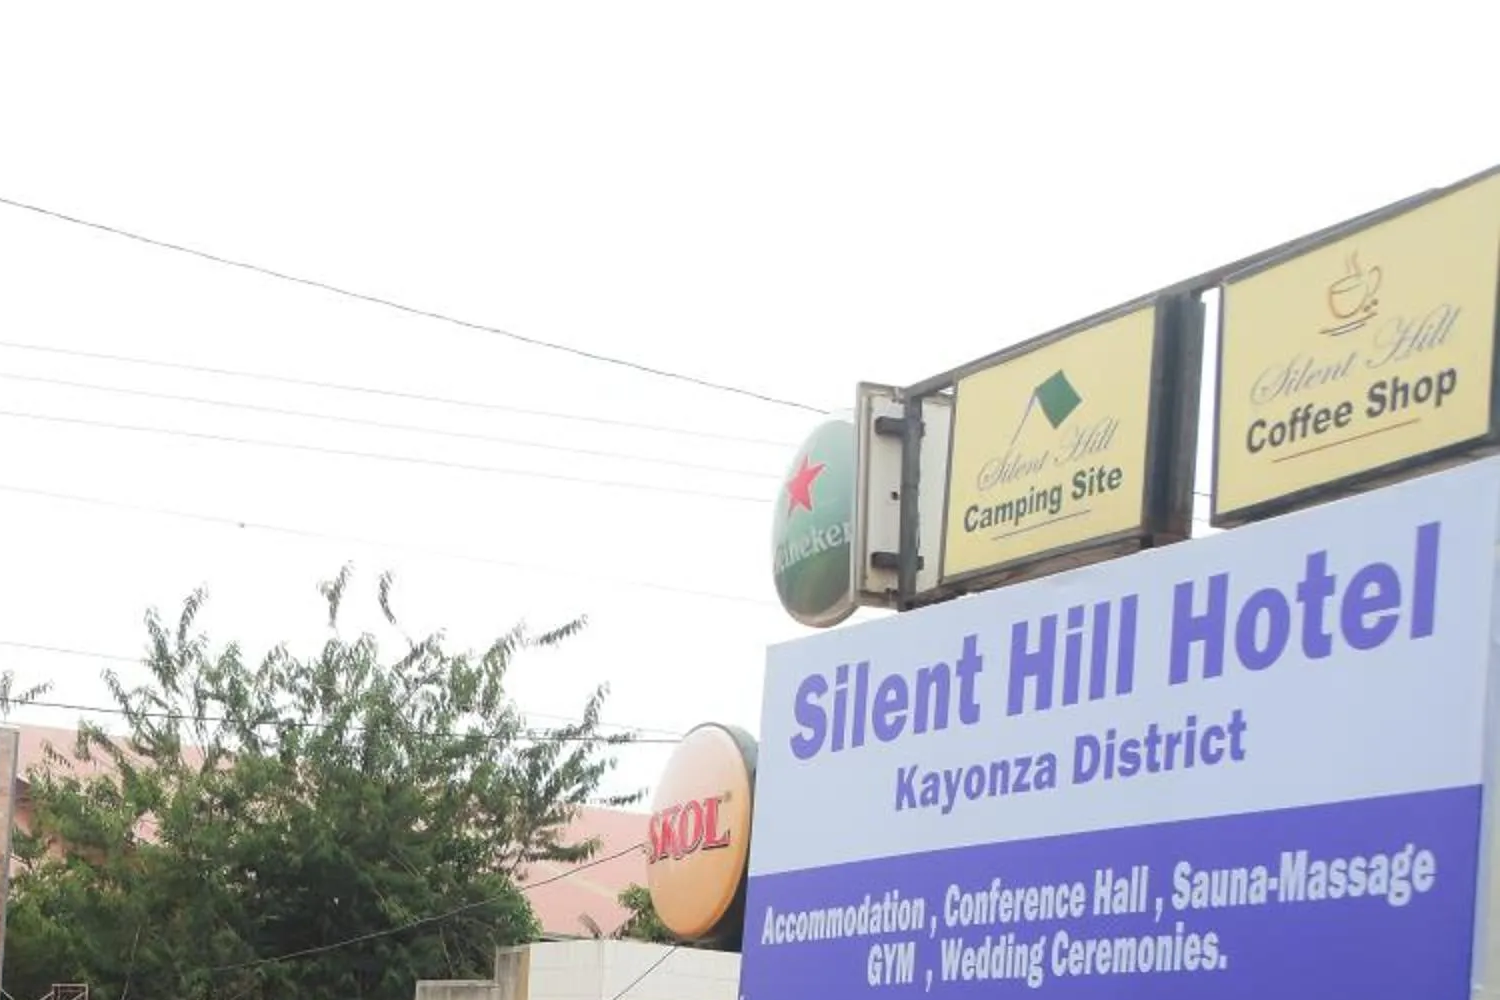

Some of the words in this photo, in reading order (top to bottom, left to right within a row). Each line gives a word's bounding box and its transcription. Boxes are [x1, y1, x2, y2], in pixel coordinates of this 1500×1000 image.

[1251, 352, 1357, 406] Silent
[1366, 304, 1461, 369] Hill
[977, 450, 1049, 492] Silent
[1053, 415, 1120, 467] Hill
[1246, 400, 1353, 453] Coffee
[1365, 367, 1457, 419] Shop
[963, 484, 1063, 533] Camping
[1071, 464, 1124, 501] Site
[790, 634, 983, 760] Silent
[1007, 594, 1139, 717] Hill
[1168, 521, 1441, 686] Hotel
[896, 752, 1057, 815] Kayonza
[1072, 709, 1247, 785] District
[761, 890, 926, 945] Accommodation
[943, 878, 1086, 928] Conference
[1093, 866, 1149, 916] Hall
[1171, 844, 1436, 907] Sauna-Massage
[867, 942, 916, 987] GYM
[941, 932, 1046, 989] Wedding
[1051, 922, 1228, 978] Ceremonies.
